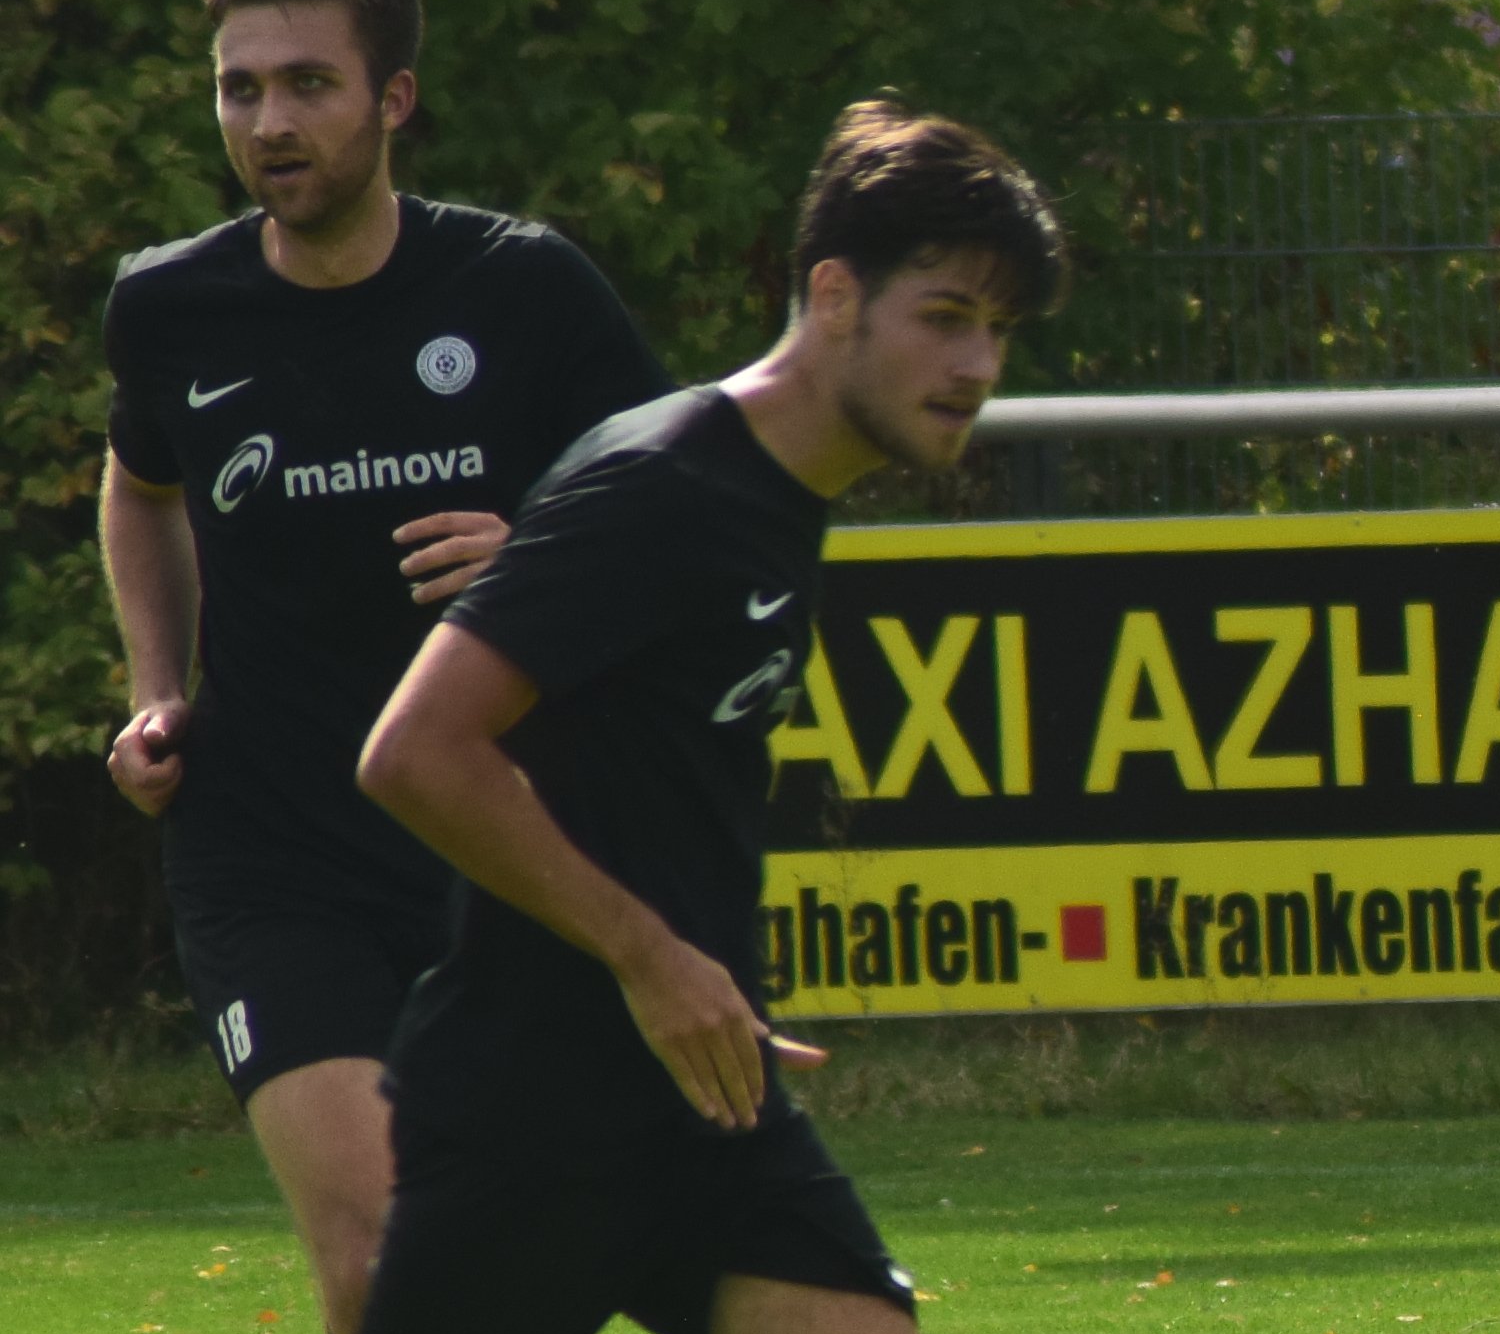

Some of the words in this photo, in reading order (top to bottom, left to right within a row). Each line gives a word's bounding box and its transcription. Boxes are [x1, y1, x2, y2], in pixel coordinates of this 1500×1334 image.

[284, 445, 484, 498] mainova
[766, 613, 1034, 802] AXI
[757, 883, 1048, 1003] ghafen-
[217, 999, 252, 1075] 18
